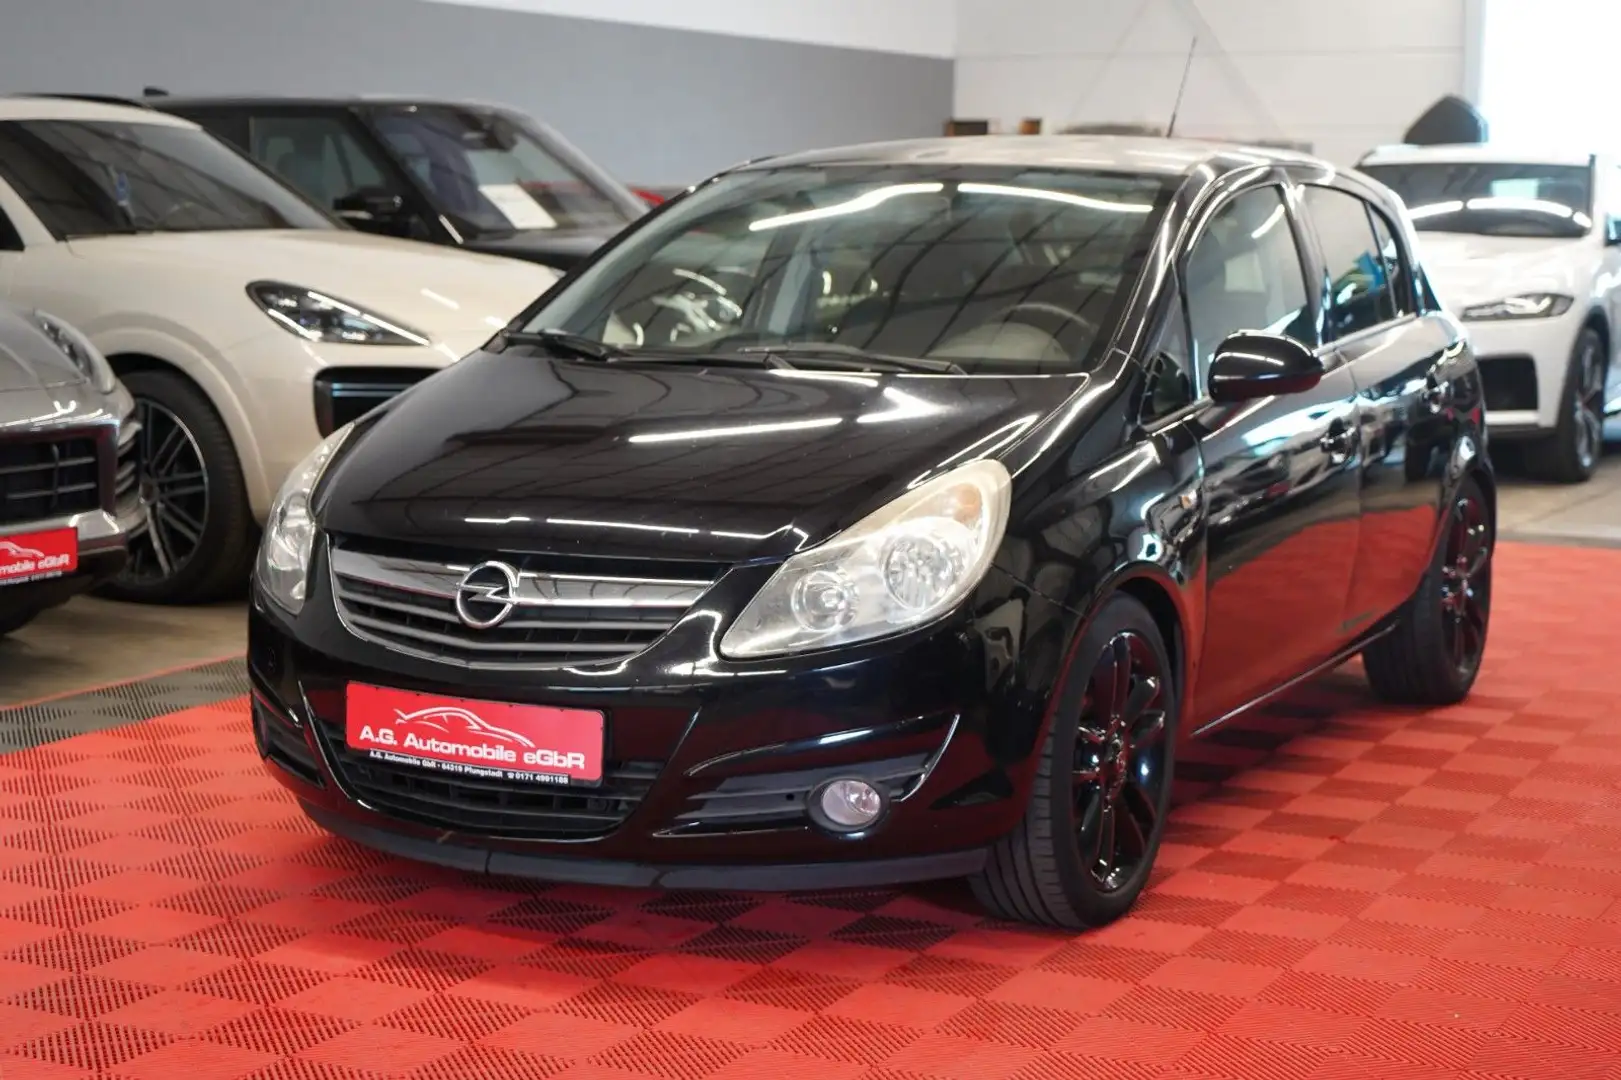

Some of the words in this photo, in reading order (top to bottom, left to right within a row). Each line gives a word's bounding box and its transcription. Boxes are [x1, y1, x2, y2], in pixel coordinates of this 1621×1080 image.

[359, 725, 398, 745] A.G.
[403, 732, 517, 763] Automobile
[523, 749, 585, 769] eGbR
[384, 752, 421, 766] Automobile
